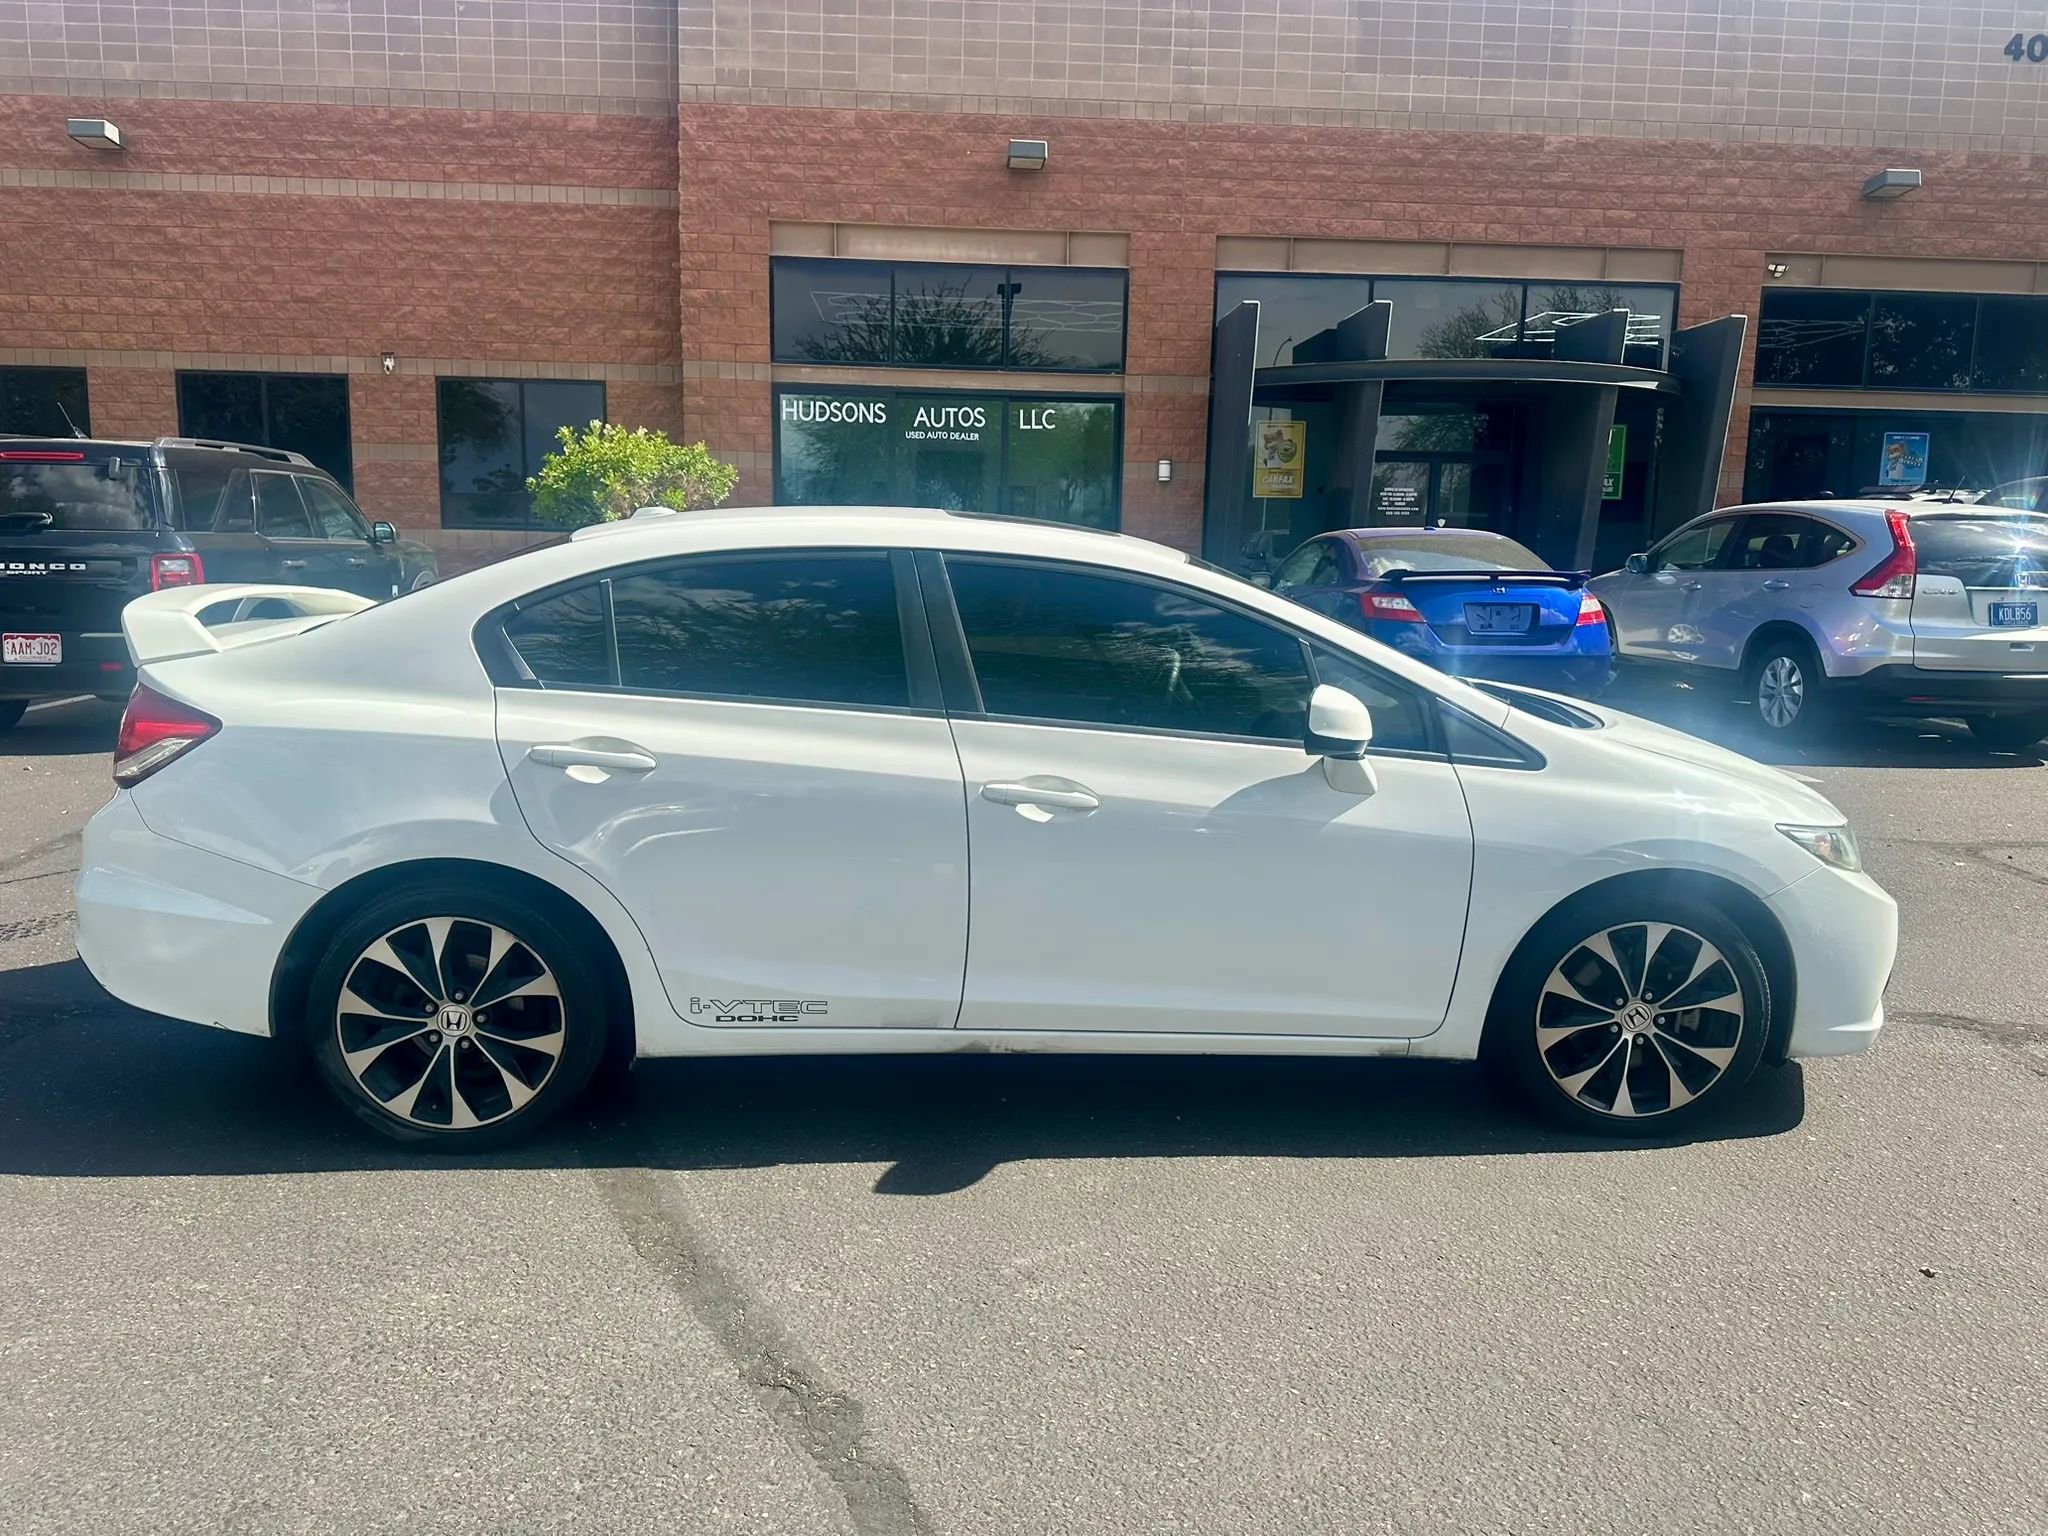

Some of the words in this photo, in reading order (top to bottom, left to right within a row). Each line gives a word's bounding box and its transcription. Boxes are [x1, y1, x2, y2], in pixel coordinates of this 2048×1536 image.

[2004, 33, 2048, 62] 40
[782, 400, 887, 424] HUDSONS
[913, 406, 986, 428] AUTOS
[1020, 409, 1056, 430] LLC
[905, 431, 925, 439] USED
[926, 431, 948, 439] AUTO
[949, 432, 979, 441] DEALER
[1263, 475, 1294, 484] CARFAX
[1998, 607, 2032, 621] KDLB56
[690, 997, 827, 1014] i-VTEC
